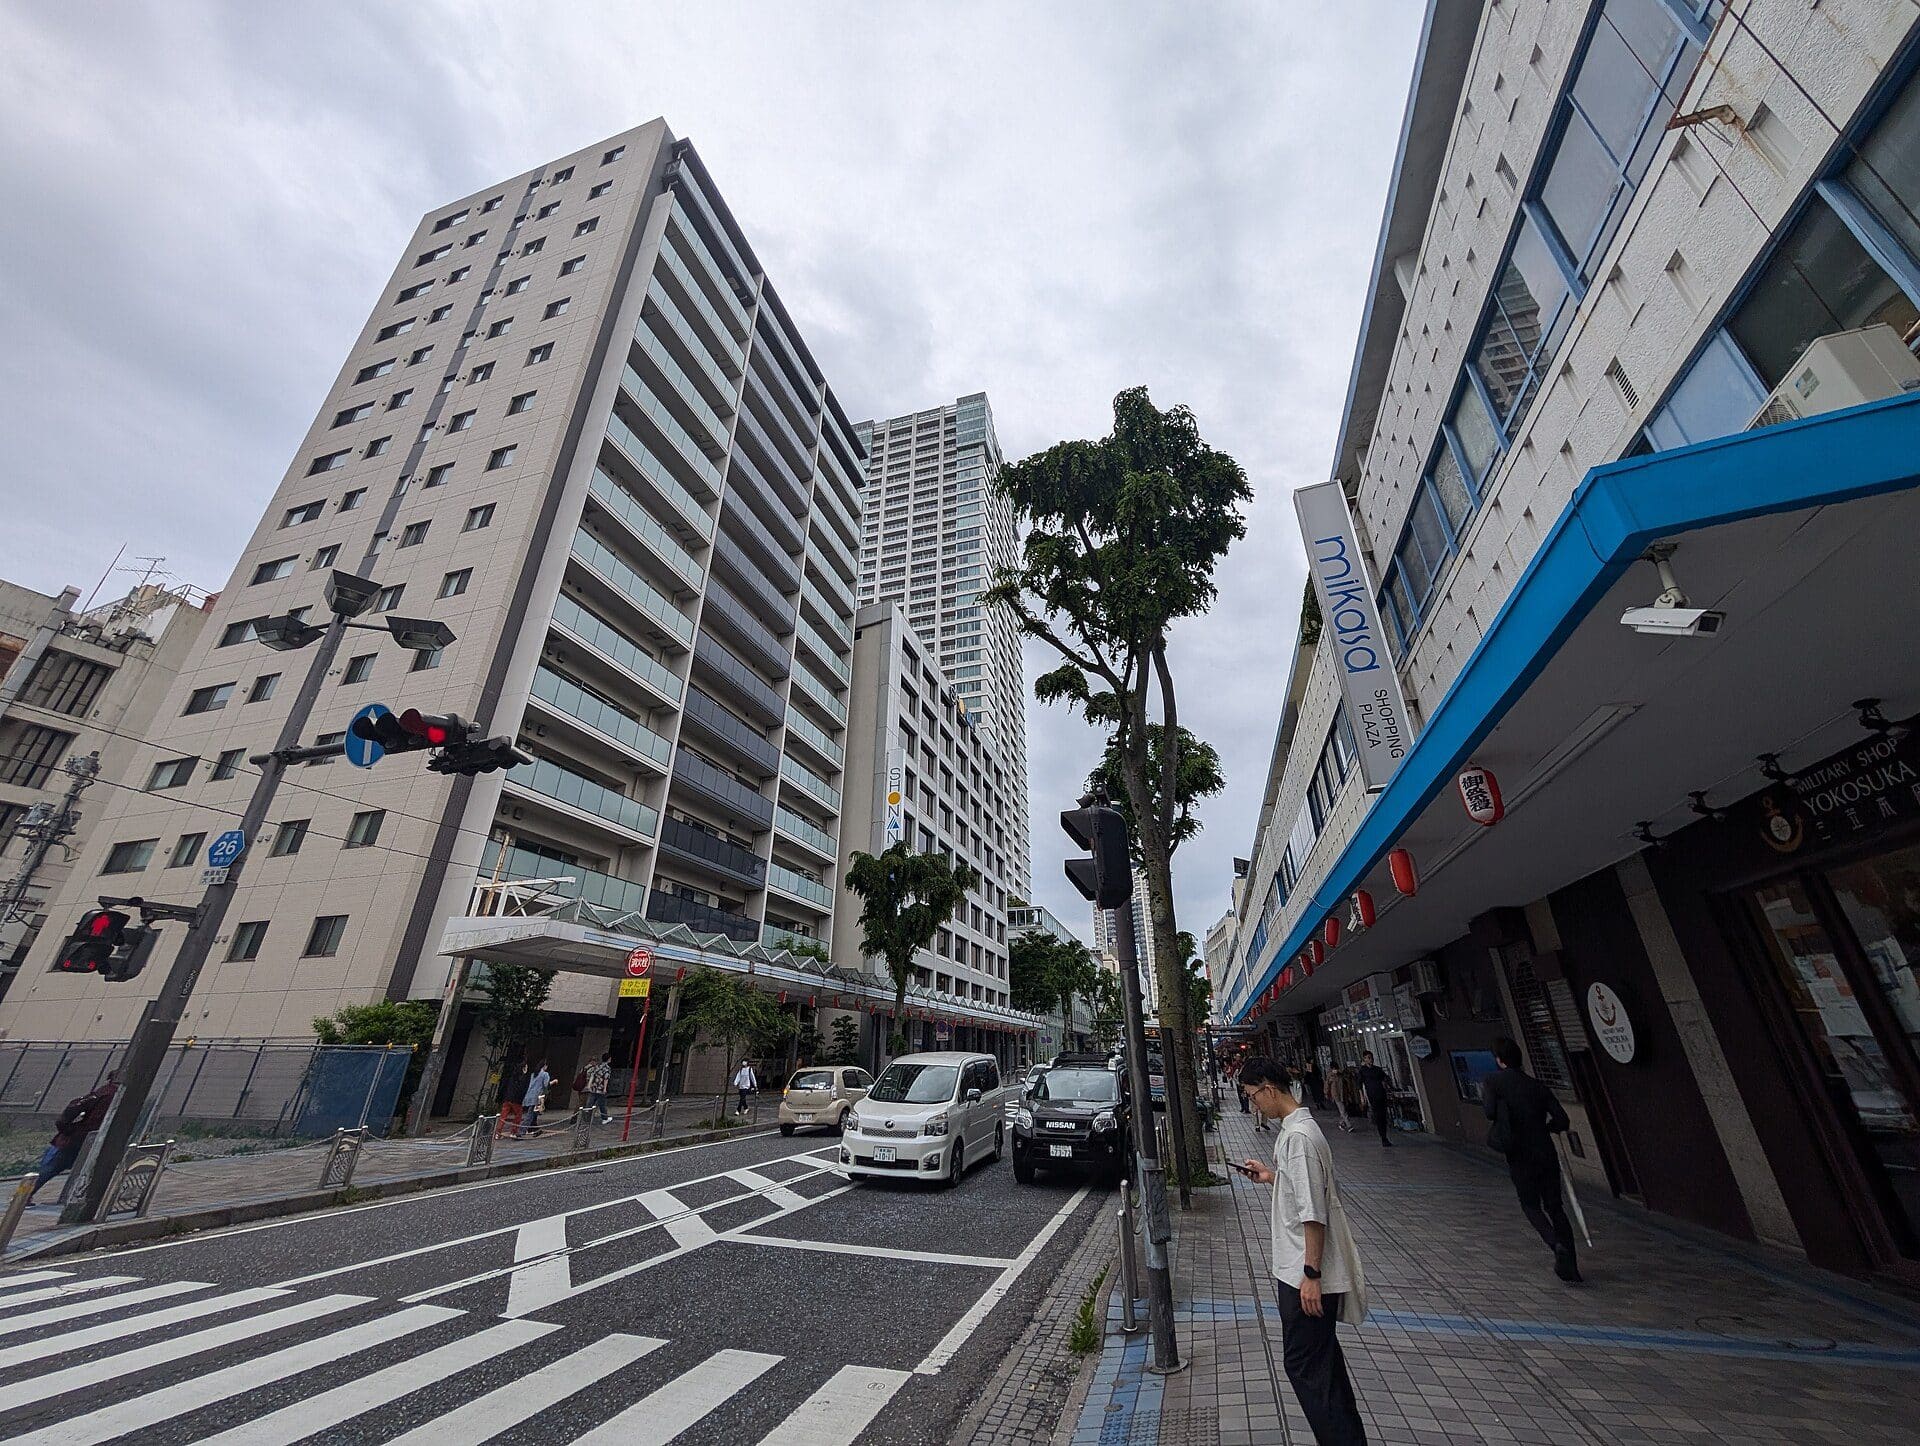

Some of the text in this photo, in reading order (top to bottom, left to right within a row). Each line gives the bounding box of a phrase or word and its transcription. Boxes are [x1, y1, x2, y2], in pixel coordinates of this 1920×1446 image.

[1314, 535, 1380, 673] mikasa
[1359, 703, 1382, 749] PLAZA
[1374, 689, 1404, 759] SHOPPING
[1797, 737, 1898, 793] MILITARY SHOP
[1803, 760, 1917, 816] YOKOSUKA
[214, 840, 237, 856] 26
[1046, 1121, 1076, 1129] NISSAN
